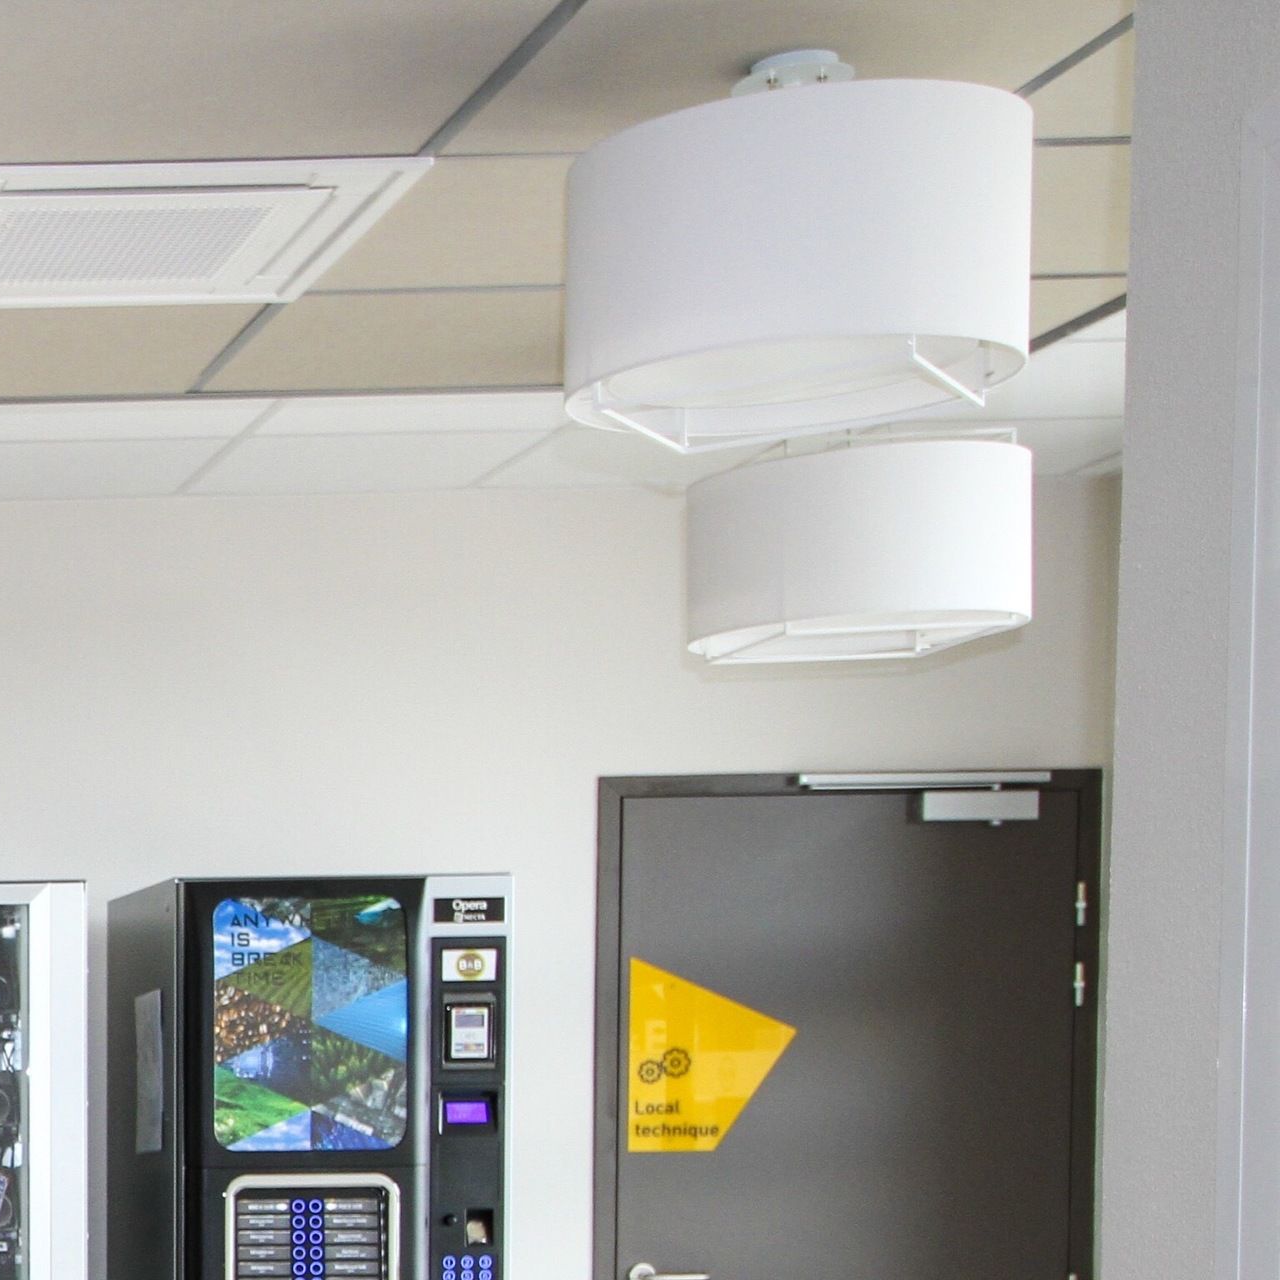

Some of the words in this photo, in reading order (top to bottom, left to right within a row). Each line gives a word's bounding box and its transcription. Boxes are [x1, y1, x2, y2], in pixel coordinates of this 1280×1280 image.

[452, 899, 488, 914] Opera
[230, 932, 251, 948] IS
[231, 951, 305, 968] BREAK
[231, 971, 283, 987] TIME
[635, 1100, 680, 1115] Local
[635, 1123, 719, 1139] technique
